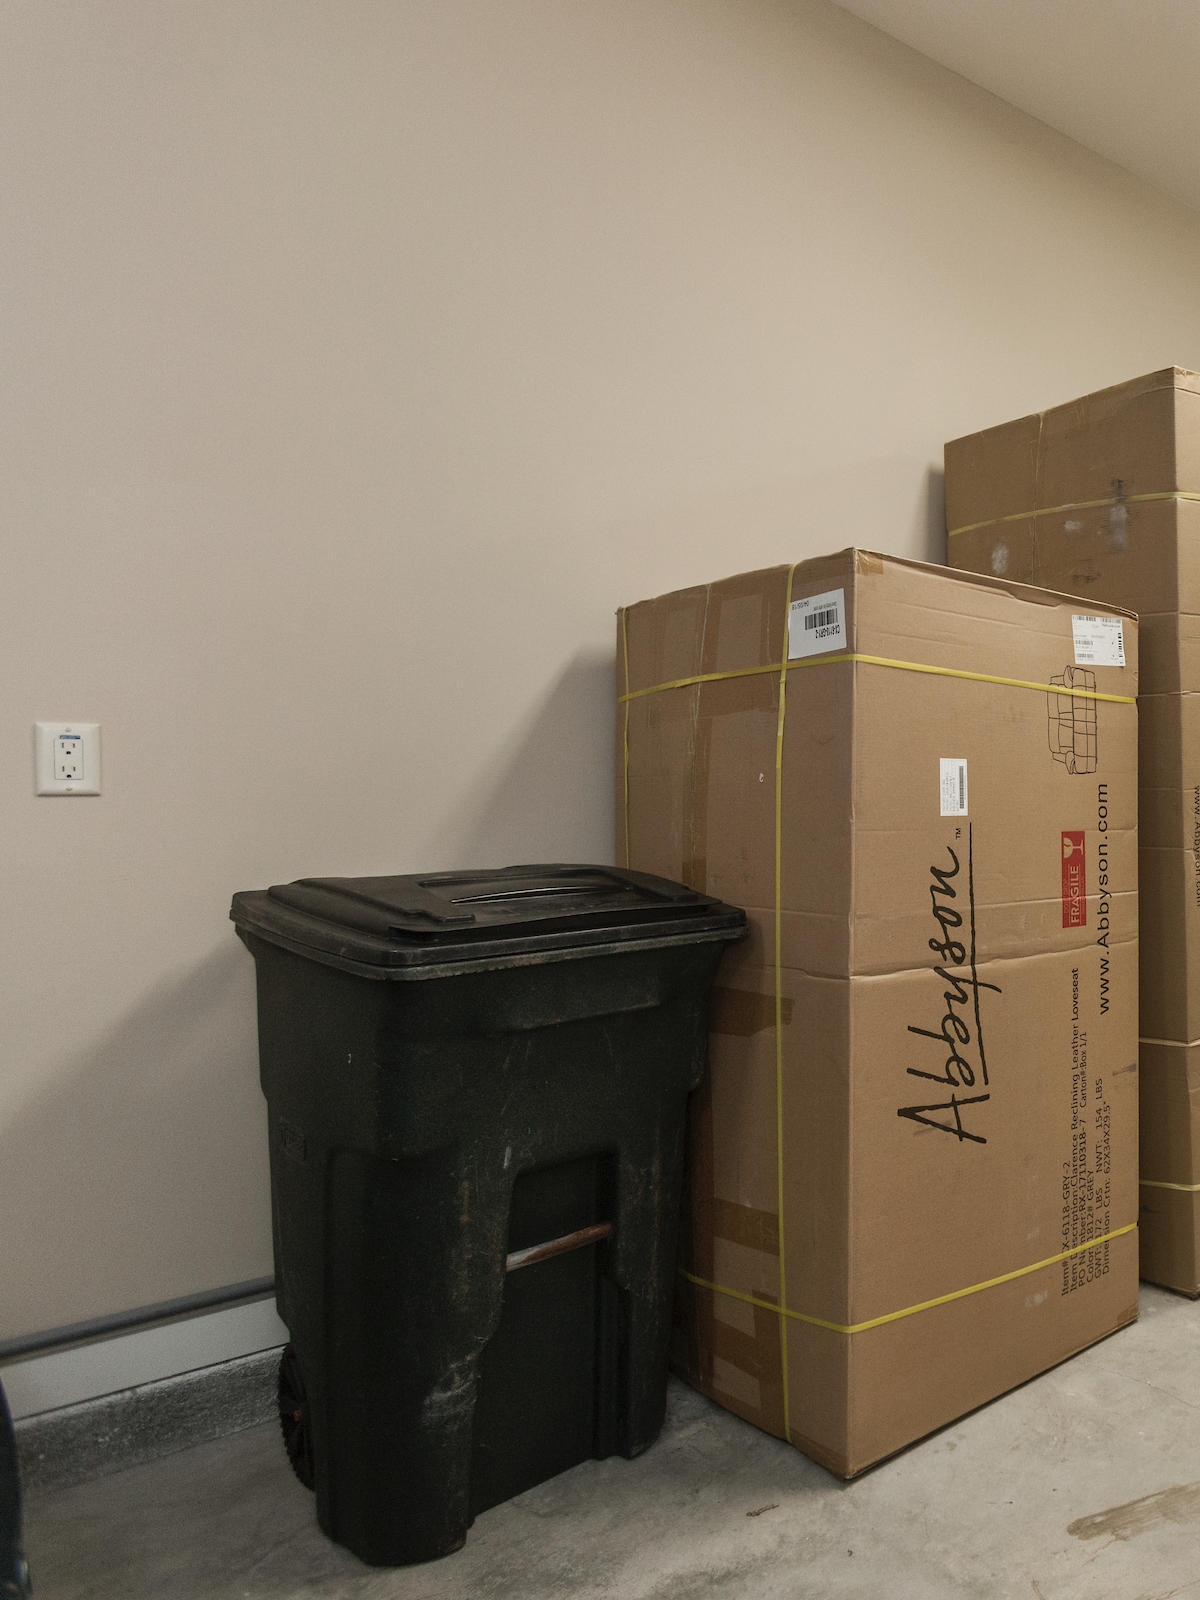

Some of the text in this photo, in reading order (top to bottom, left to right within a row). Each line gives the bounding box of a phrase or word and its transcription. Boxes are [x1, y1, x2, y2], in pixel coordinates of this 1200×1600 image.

[1070, 866, 1079, 923] FRAGILE
[1096, 783, 1112, 1016] www.Abbyson.com
[897, 846, 1002, 1144] Abbyson
[1071, 967, 1079, 1021] Loveseat
[1071, 1024, 1079, 1070] Leather
[1070, 1074, 1080, 1130] Reclining
[1095, 1078, 1103, 1100] LBS
[1095, 1108, 1103, 1129] 154
[1095, 1140, 1103, 1173] NWT:
[1061, 1162, 1070, 1297] Item# X-6118-GRY-2
[1070, 1263, 1078, 1292] Item
[1078, 1268, 1085, 1287] PO
